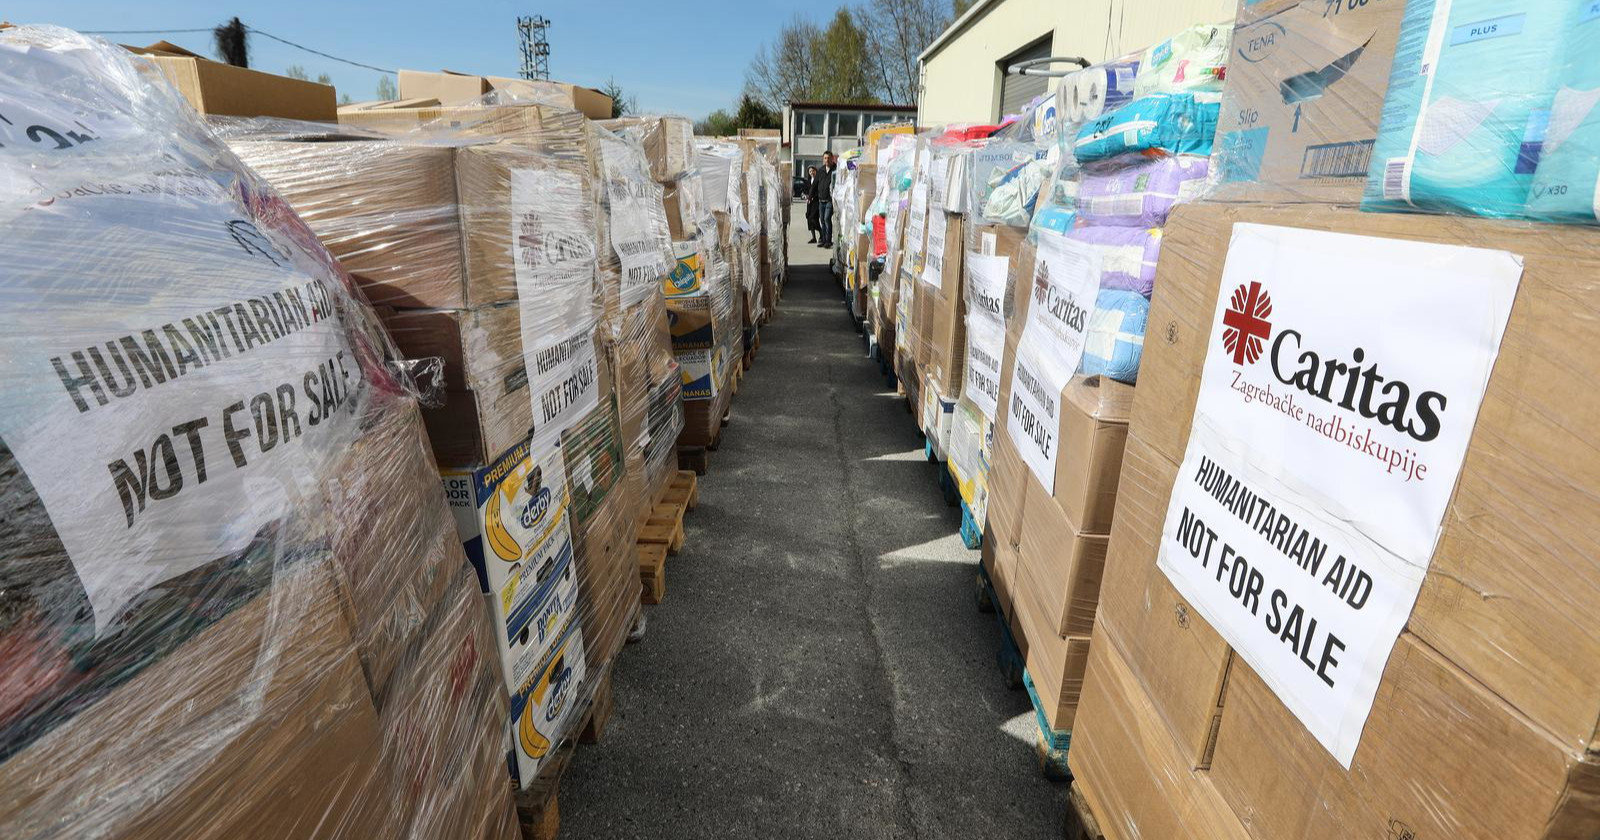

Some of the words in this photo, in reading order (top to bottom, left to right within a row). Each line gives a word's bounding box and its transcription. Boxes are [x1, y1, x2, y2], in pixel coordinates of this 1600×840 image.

[1247, 32, 1275, 53] TENA
[1470, 24, 1498, 36] PLUS
[1238, 108, 1259, 128] Slip
[1547, 184, 1568, 196] x30
[1047, 285, 1087, 334] Caritas
[51, 286, 312, 413] HUMANITARIAN
[305, 278, 333, 323] AID
[541, 384, 562, 424] NOT
[562, 374, 580, 409] FOR
[578, 359, 593, 396] SALE
[683, 389, 711, 397] NANAS
[1270, 328, 1448, 442] Caritas
[107, 417, 209, 529] NOT
[223, 383, 302, 468] FOR
[303, 350, 352, 427] SALE
[1021, 405, 1035, 439] FOR
[1034, 420, 1052, 460] SALE
[1231, 370, 1304, 422] Zagrebačke
[1306, 410, 1428, 482] nadbiskupije
[449, 480, 468, 489] OF
[483, 447, 526, 488] PREMIUM
[449, 500, 470, 508] PACK
[523, 490, 550, 526] derby
[1194, 455, 1328, 578] HUMANITARIAN
[1322, 554, 1374, 611] AID
[1176, 507, 1219, 569] NOT
[1216, 543, 1265, 617] FOR
[1265, 588, 1346, 689] SALE
